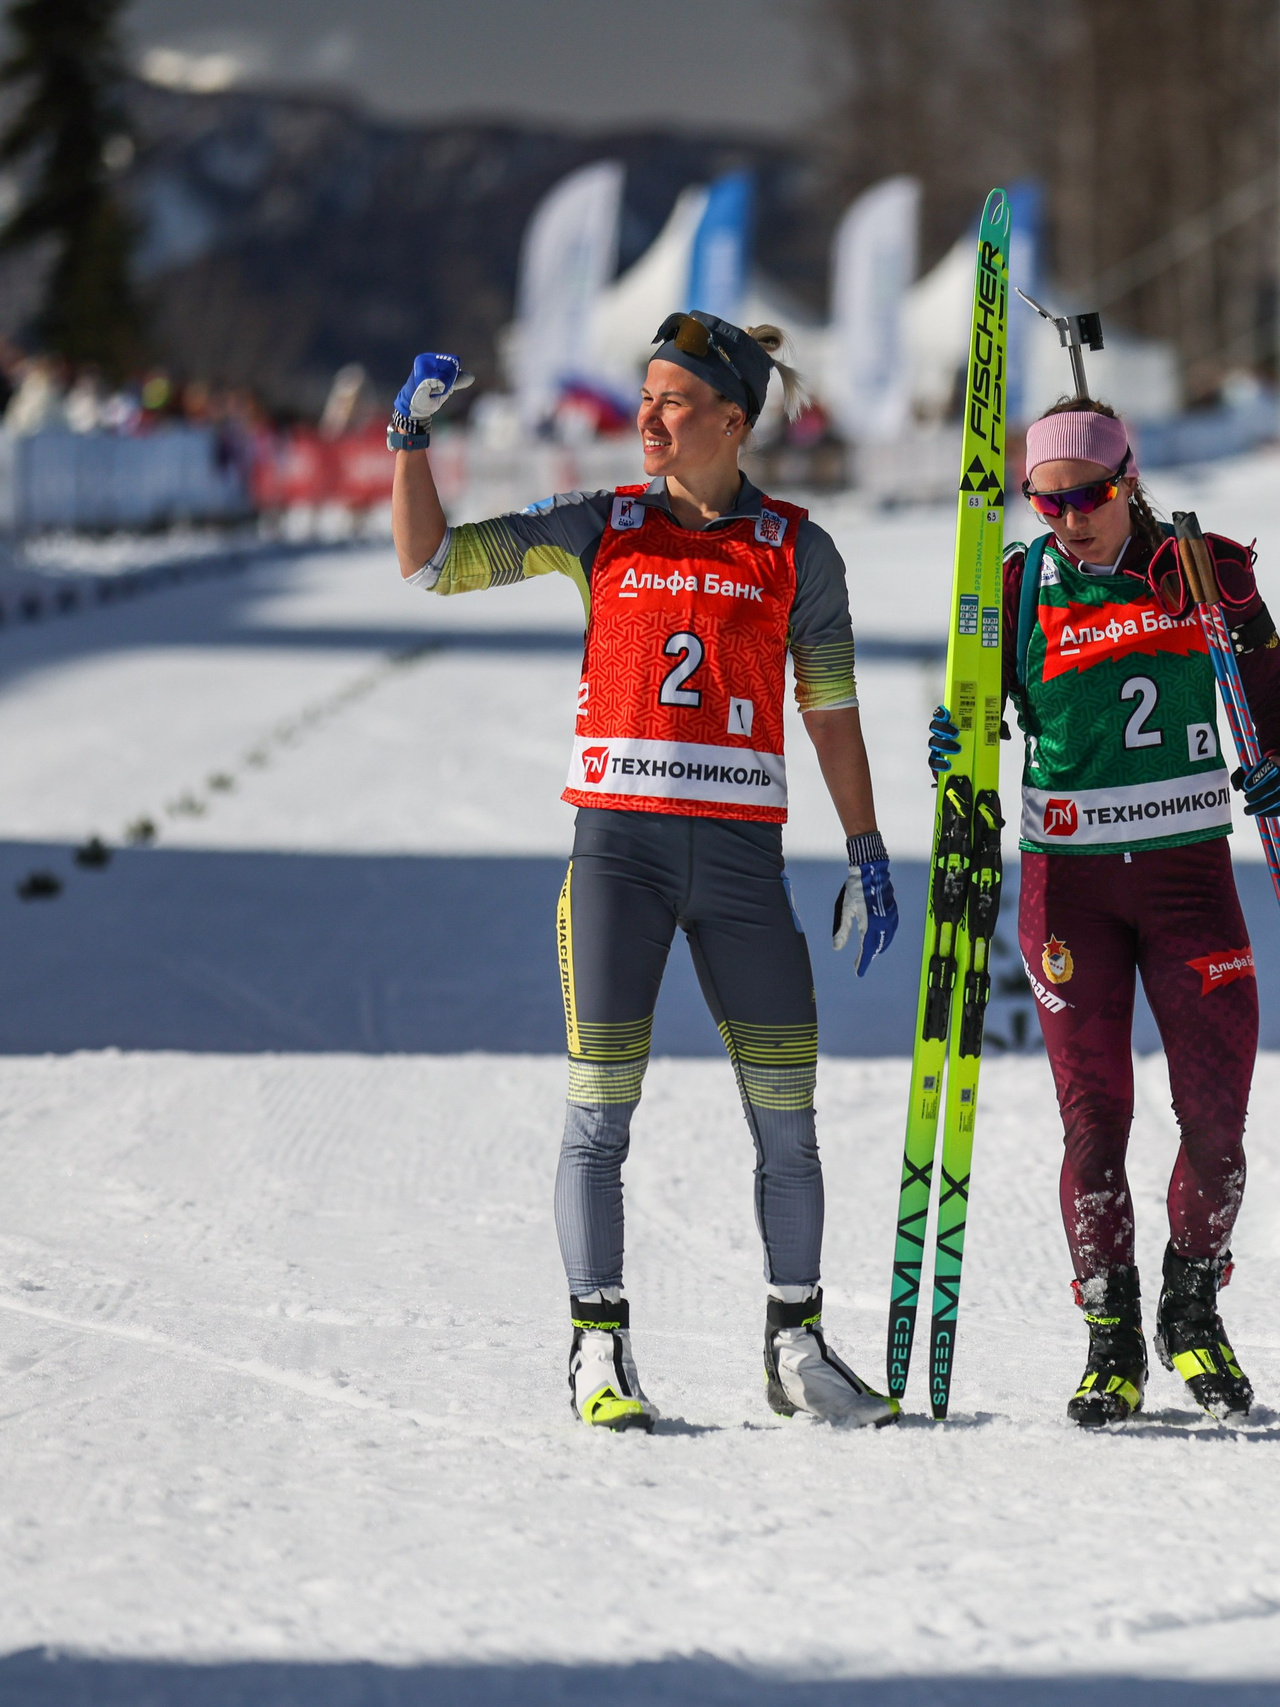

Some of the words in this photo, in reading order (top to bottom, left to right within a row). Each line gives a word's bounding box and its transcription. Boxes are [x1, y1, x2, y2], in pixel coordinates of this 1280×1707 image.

[971, 241, 999, 440] FISCHER
[969, 498, 979, 506] 63
[987, 513, 997, 521] 63
[974, 542, 983, 591] SPEEDMAX
[620, 567, 698, 595] Альфа
[704, 574, 764, 603] Банк
[1060, 619, 1138, 646] Альфа
[658, 630, 705, 707] 2
[1119, 674, 1163, 749] 2
[1196, 729, 1208, 755] 2
[612, 757, 771, 786] ТЕХНОНИКОЛЬ
[1208, 957, 1248, 976] Альфа
[891, 1316, 910, 1390] SPEED
[933, 1331, 950, 1405] SPEED
